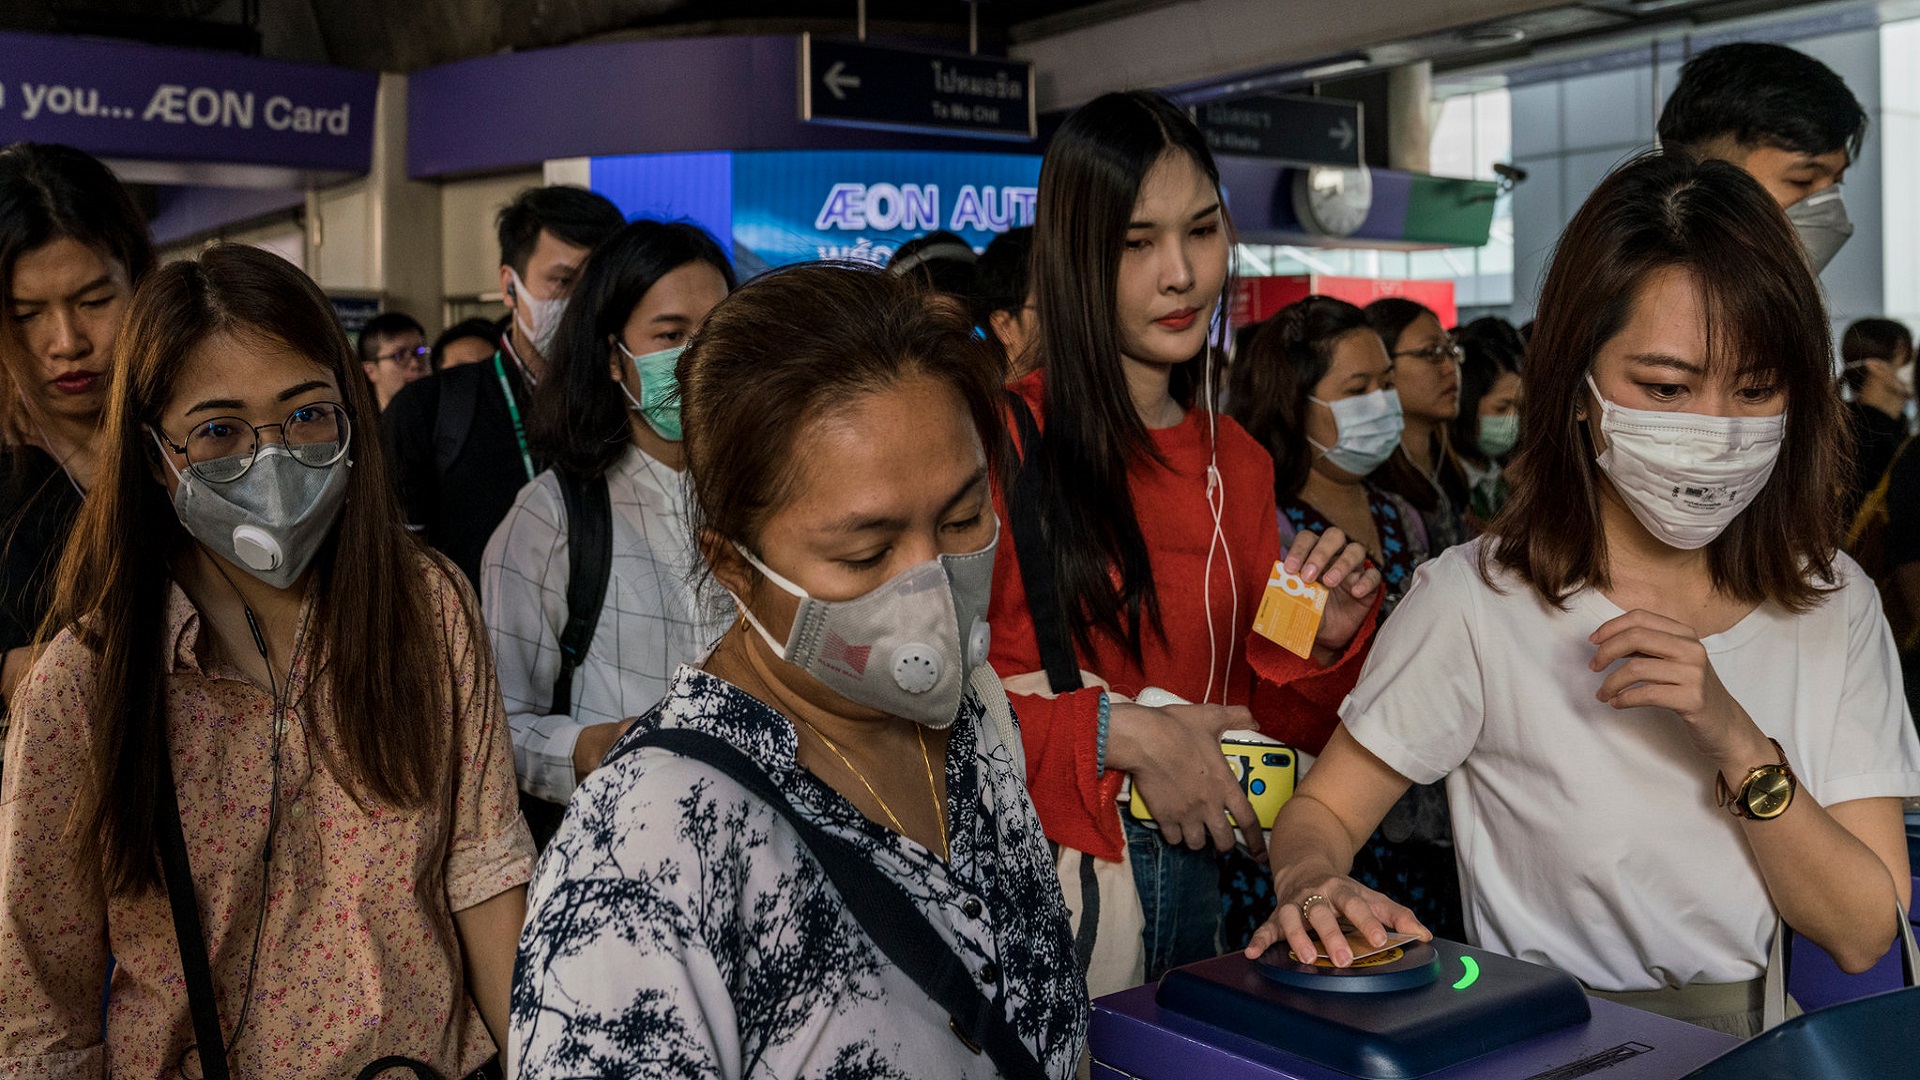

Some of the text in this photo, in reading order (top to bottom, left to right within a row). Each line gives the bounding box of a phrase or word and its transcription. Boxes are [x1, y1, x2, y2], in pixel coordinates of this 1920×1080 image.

[22, 82, 134, 120] you...
[143, 84, 254, 129] ÆON
[263, 96, 350, 135] Card
[815, 183, 940, 231] ÆON
